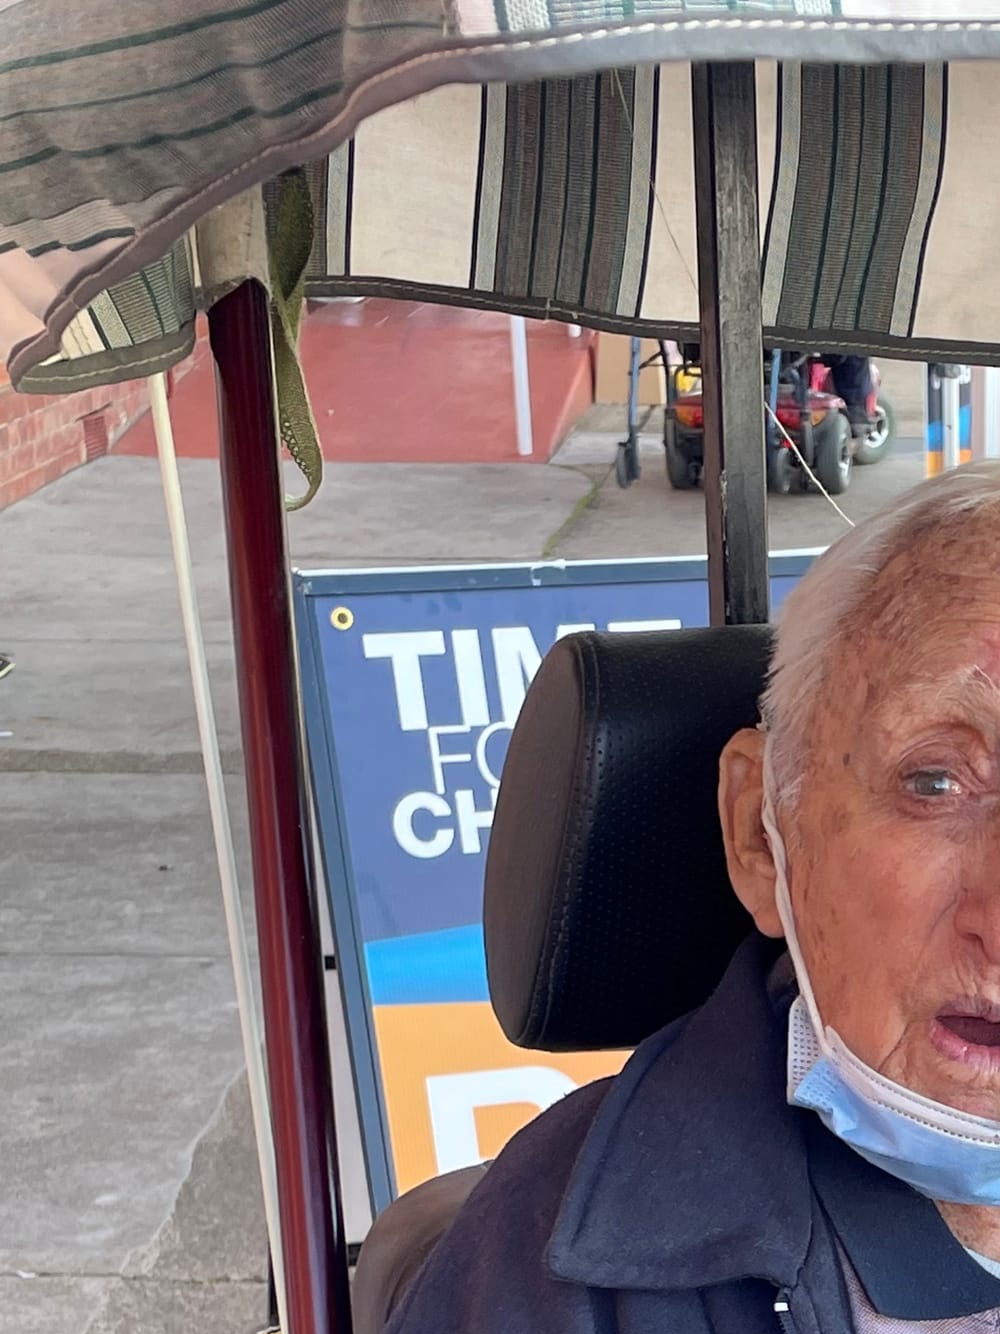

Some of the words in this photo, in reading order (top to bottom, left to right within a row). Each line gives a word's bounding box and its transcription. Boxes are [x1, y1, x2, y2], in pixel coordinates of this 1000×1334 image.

[362, 619, 682, 731] TIM
[428, 721, 515, 795] FO
[393, 788, 501, 858] CH
